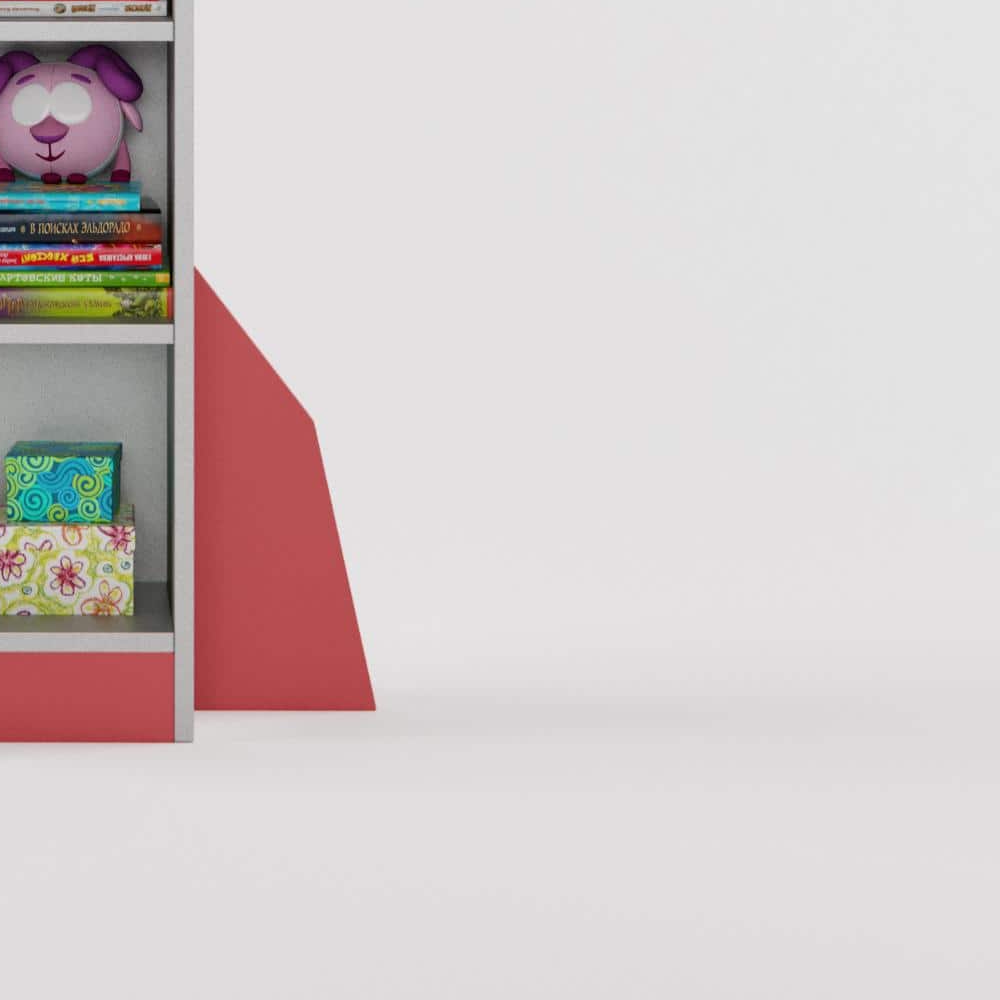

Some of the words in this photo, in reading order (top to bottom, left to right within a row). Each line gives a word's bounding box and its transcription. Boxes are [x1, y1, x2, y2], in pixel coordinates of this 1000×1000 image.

[29, 222, 36, 234] В
[38, 221, 79, 235] ПОИСКАХ
[81, 221, 130, 235] ЭЛЬДОРАДО
[69, 272, 103, 282] КОТЫ
